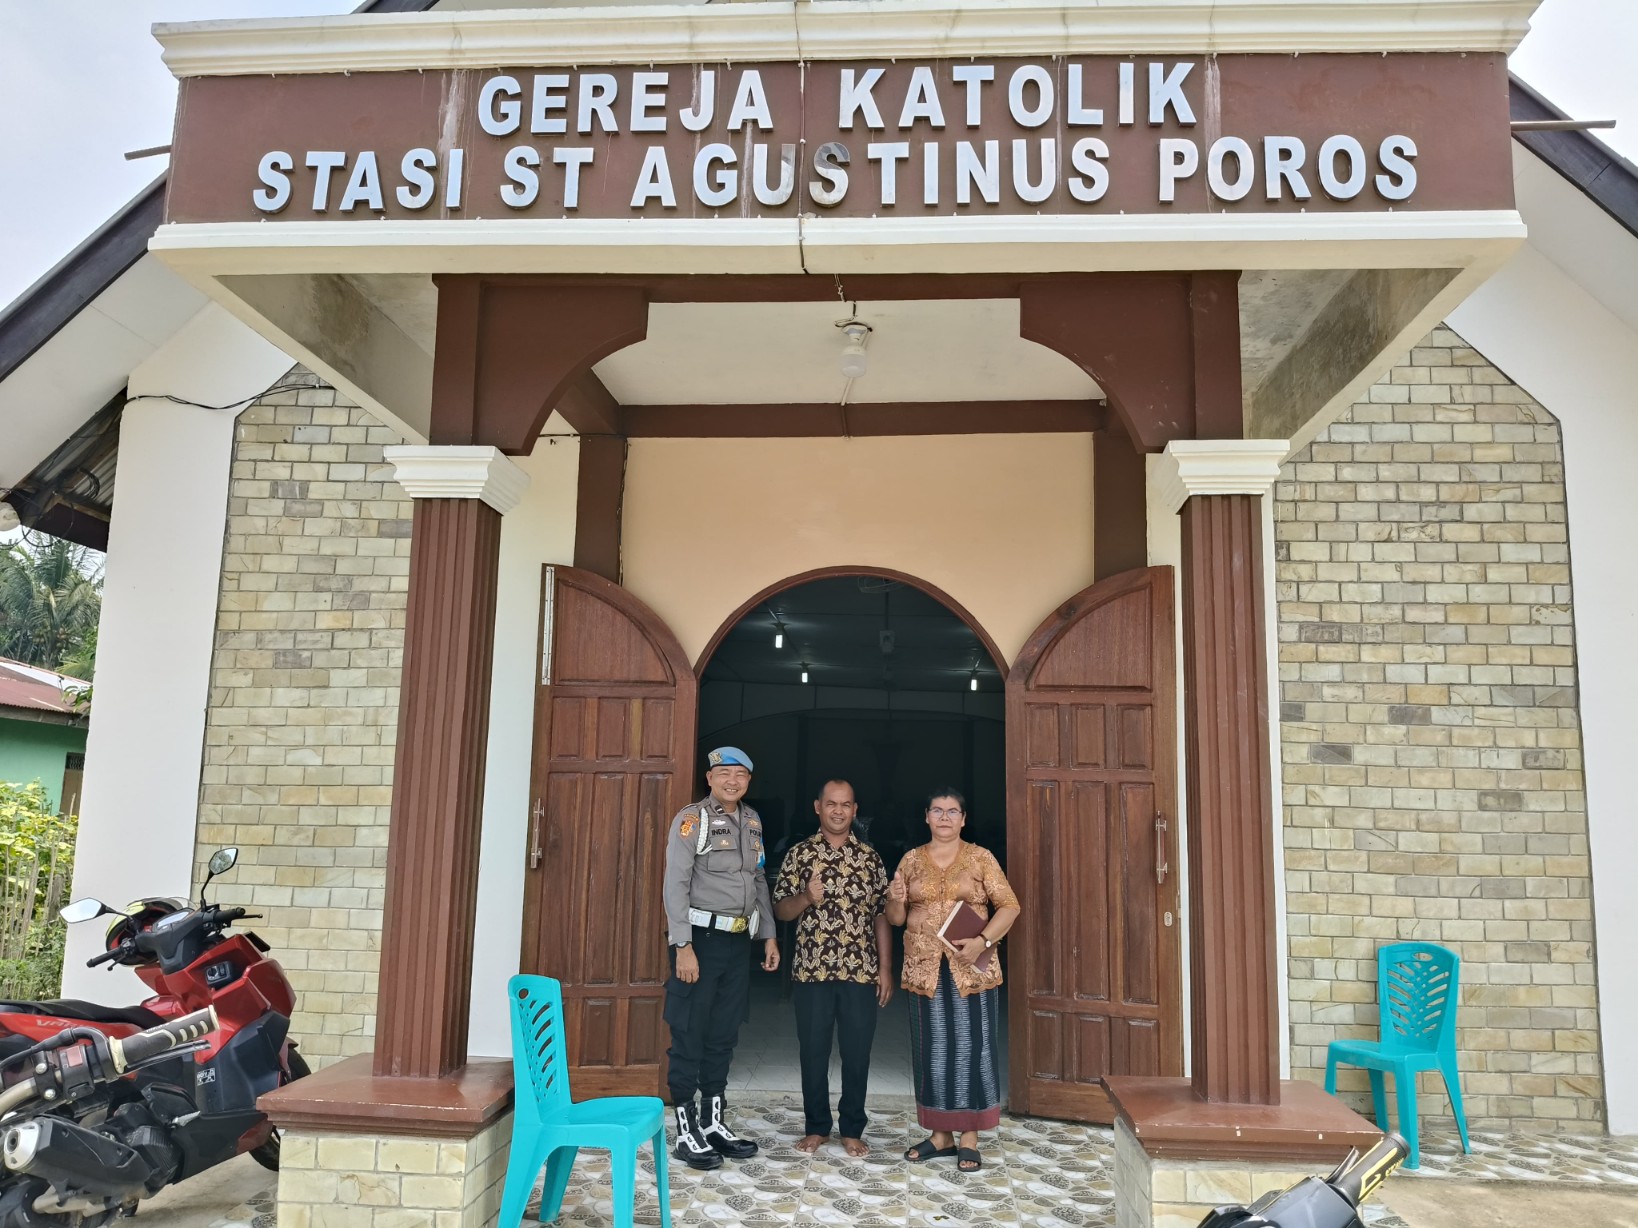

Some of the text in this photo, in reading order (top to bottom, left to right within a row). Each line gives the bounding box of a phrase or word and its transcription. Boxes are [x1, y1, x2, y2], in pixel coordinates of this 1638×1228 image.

[478, 62, 1196, 136] GEREJA KATOLIK
[252, 134, 1418, 213] STASI ST AGUSTINUS POROS
[711, 828, 731, 836] INDRA
